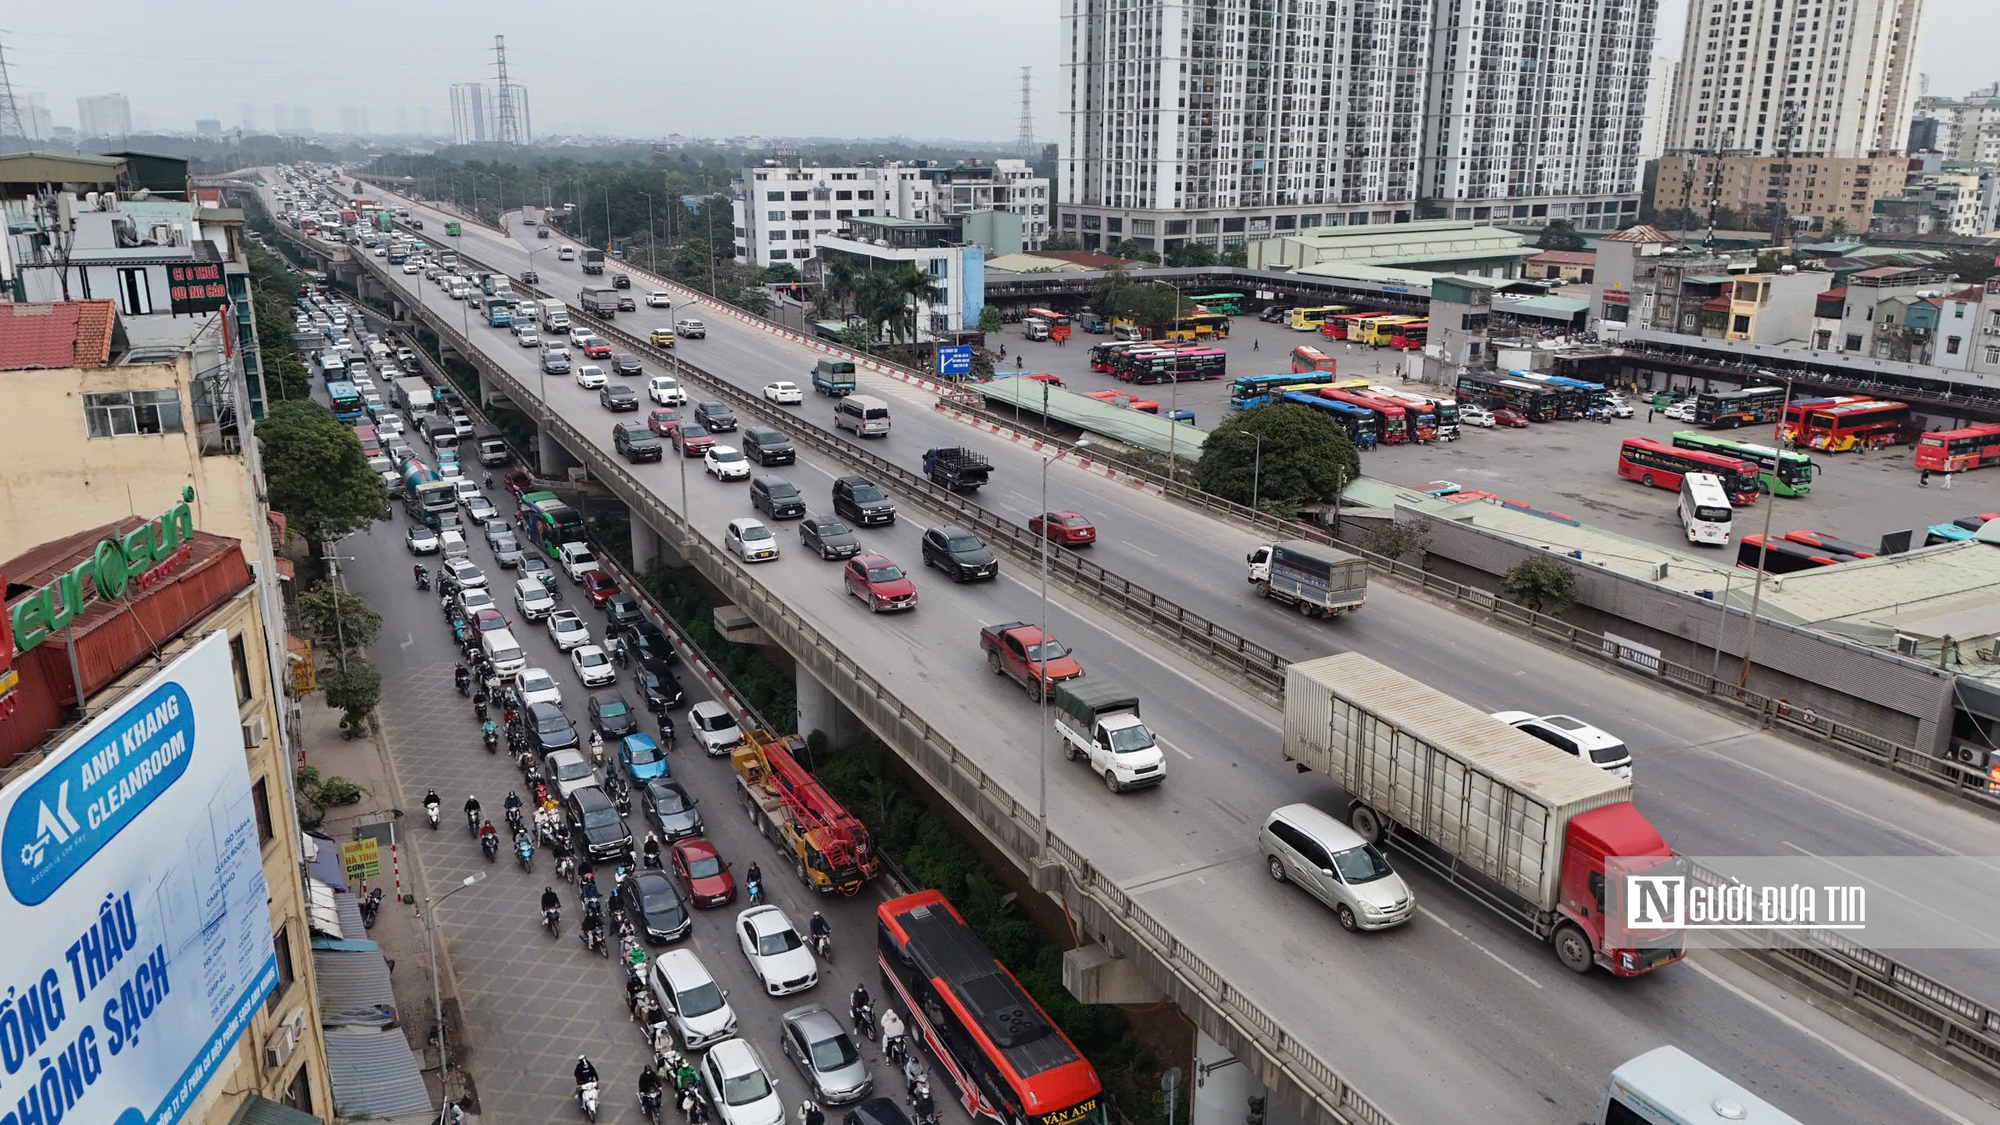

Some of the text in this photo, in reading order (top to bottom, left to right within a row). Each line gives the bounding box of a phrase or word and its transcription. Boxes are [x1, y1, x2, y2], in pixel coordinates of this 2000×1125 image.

[194, 263, 219, 280] THUÊ
[205, 281, 226, 298] CÁO
[13, 503, 193, 651] eurosun
[81, 694, 181, 792] ANH KHANG
[87, 730, 186, 830] CLEANROOM
[364, 841, 375, 850] AN
[345, 854, 357, 865] HÀ
[346, 863, 365, 873] CƠM
[348, 871, 365, 880] PHỞ
[0, 890, 137, 1076] ỔNG THẦU
[103, 943, 170, 1056] SẠCH
[1041, 1099, 1097, 1125] VÂN ANH
